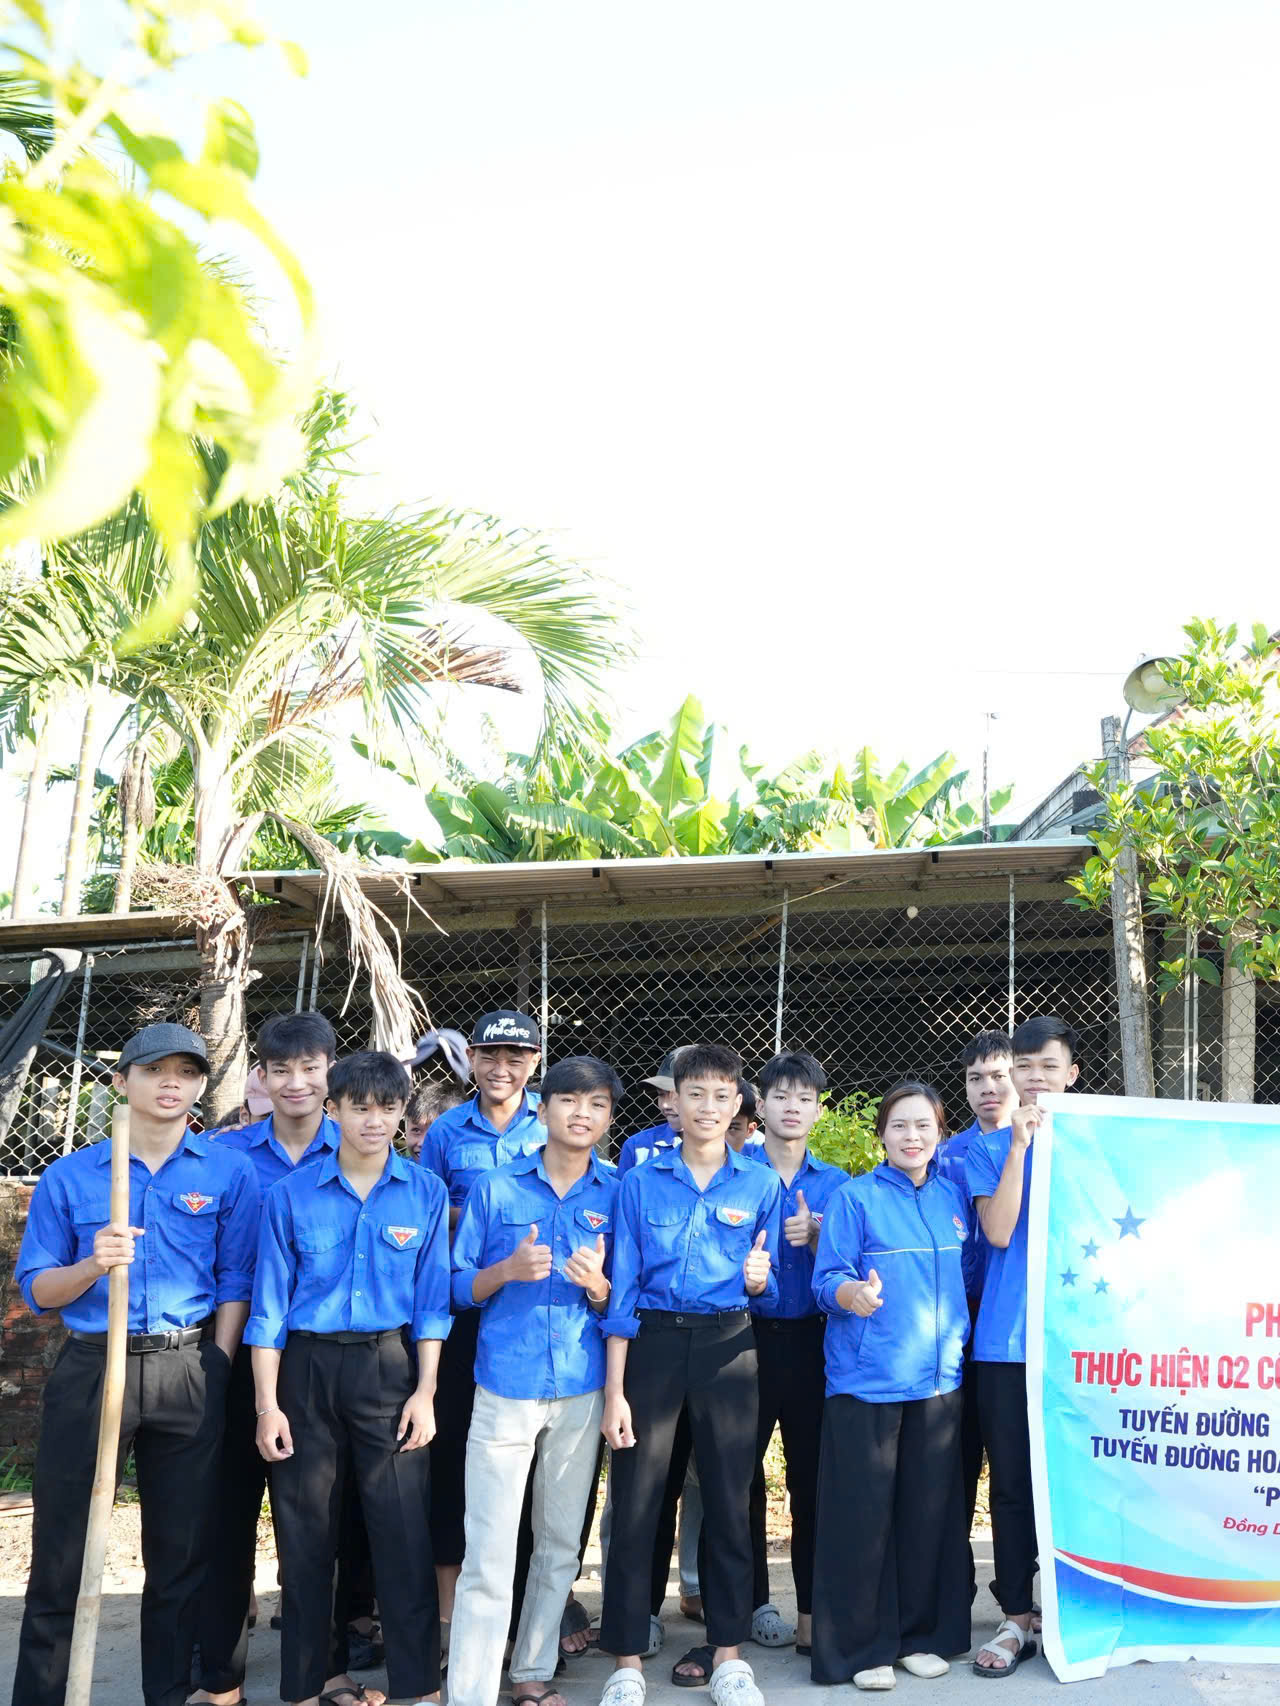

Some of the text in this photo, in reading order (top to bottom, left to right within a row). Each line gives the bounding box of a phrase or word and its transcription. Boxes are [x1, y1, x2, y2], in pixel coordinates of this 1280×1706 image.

[1071, 1348, 1143, 1394] THỰC
[1150, 1347, 1209, 1396] HIỆN
[1217, 1355, 1250, 1389] 02
[1119, 1403, 1188, 1436] TUYẾN
[1196, 1406, 1270, 1437] ĐƯỜNG
[1090, 1435, 1158, 1465] TUYẾN
[1164, 1442, 1240, 1473] ĐƯỜNG
[1223, 1516, 1268, 1537] Đồng
